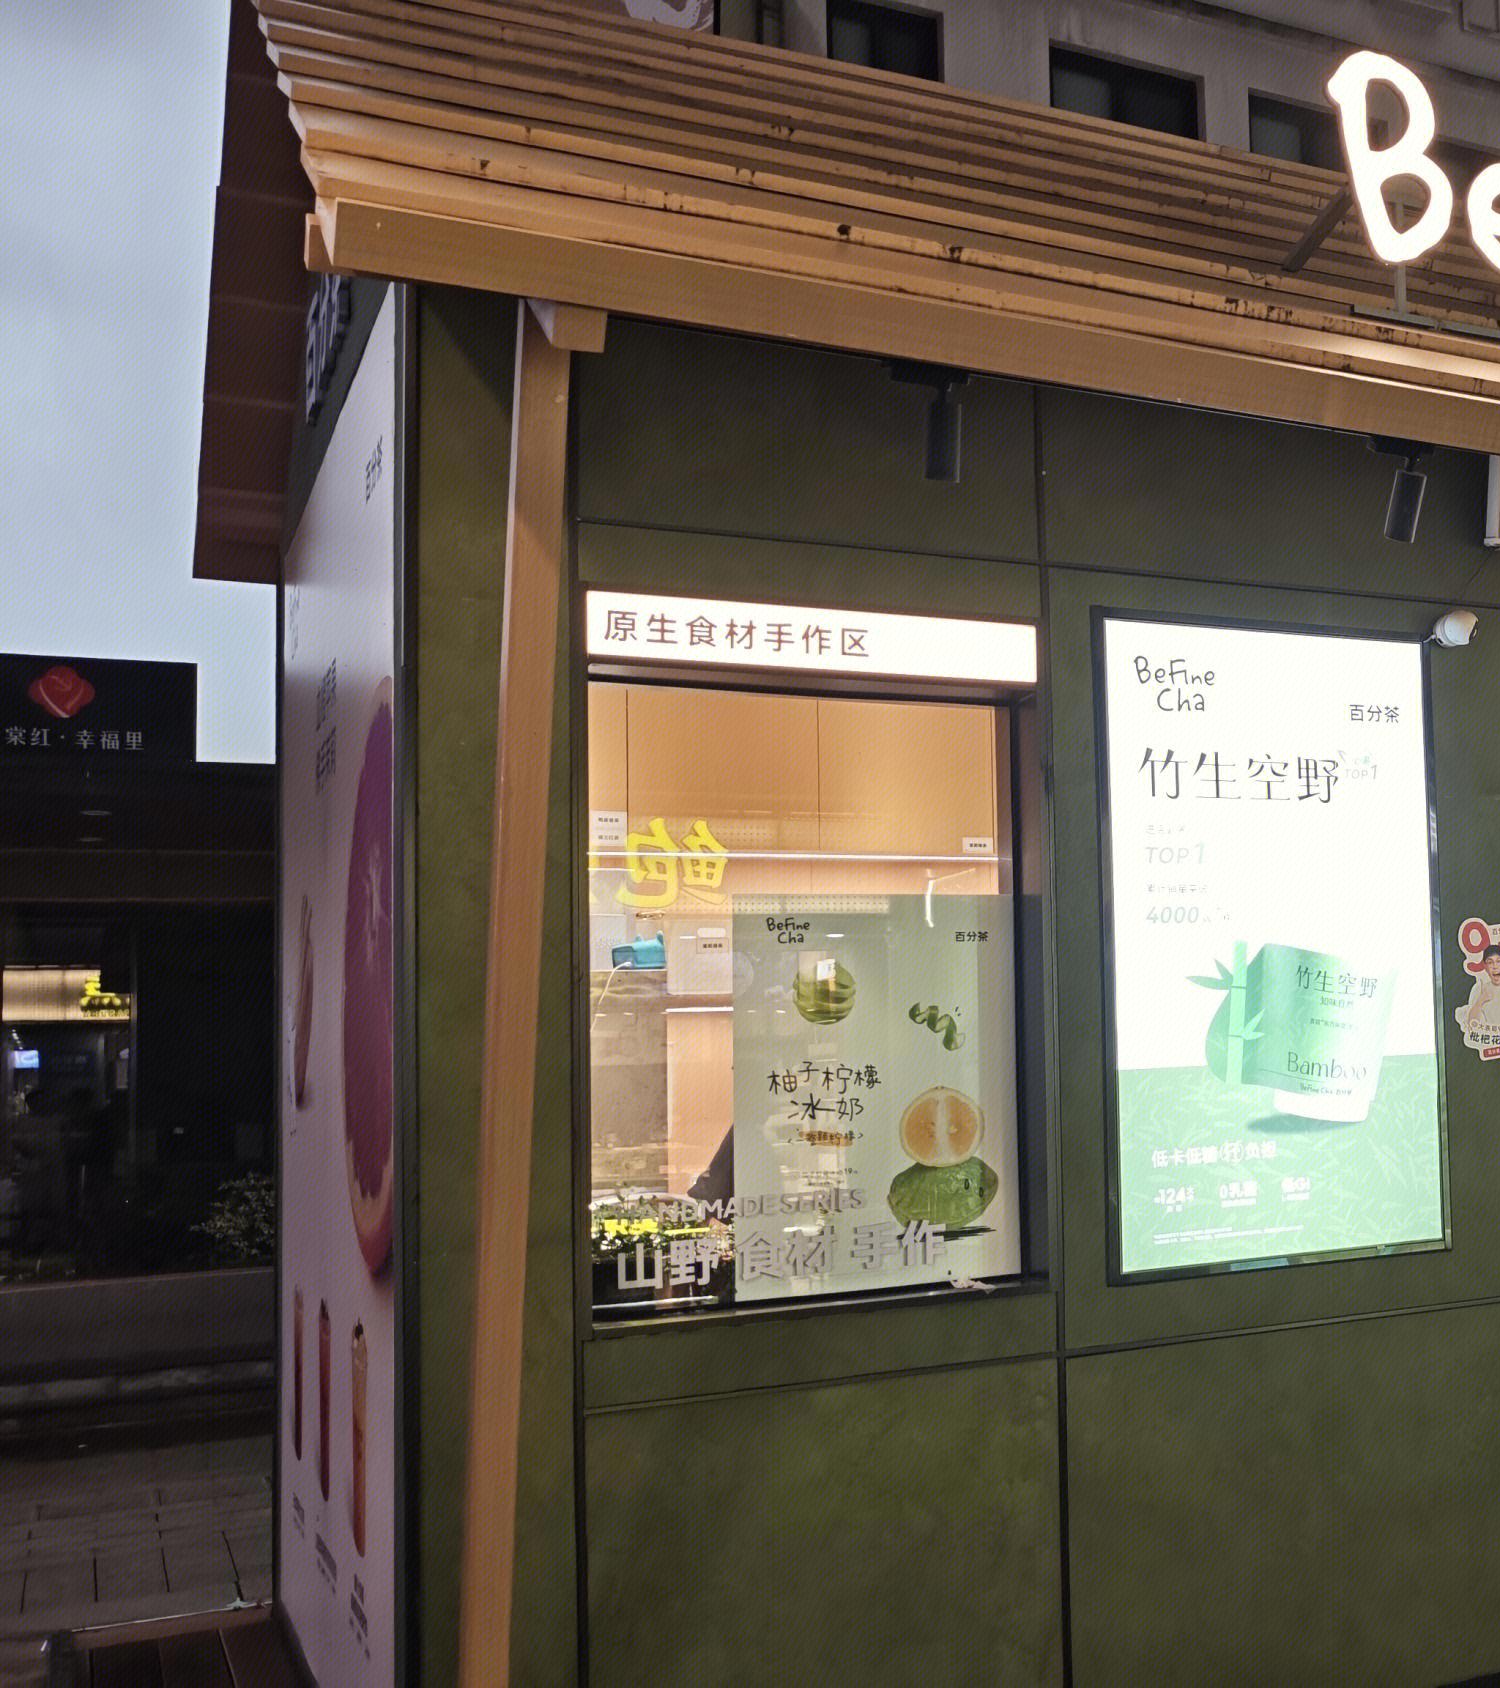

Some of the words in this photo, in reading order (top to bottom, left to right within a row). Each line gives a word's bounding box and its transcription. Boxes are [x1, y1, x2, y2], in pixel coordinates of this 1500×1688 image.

[603, 609, 870, 658] 原生食材手作区
[1133, 655, 1216, 686] BeFine
[1157, 688, 1206, 711] Cha
[1349, 704, 1400, 723] 百分茶
[1138, 747, 1339, 804] 竹生空野
[766, 917, 811, 931] BeFine
[777, 932, 805, 944] Cha
[955, 930, 990, 943] 百分茶
[1296, 964, 1378, 999] 竹生空野
[767, 1061, 882, 1095] 柚子柠檬
[787, 1092, 865, 1122] 冰奶
[779, 1187, 867, 1216] SERIES
[617, 1238, 721, 1291] 山野
[736, 1224, 837, 1283] 食材
[850, 1218, 947, 1270] 手作
